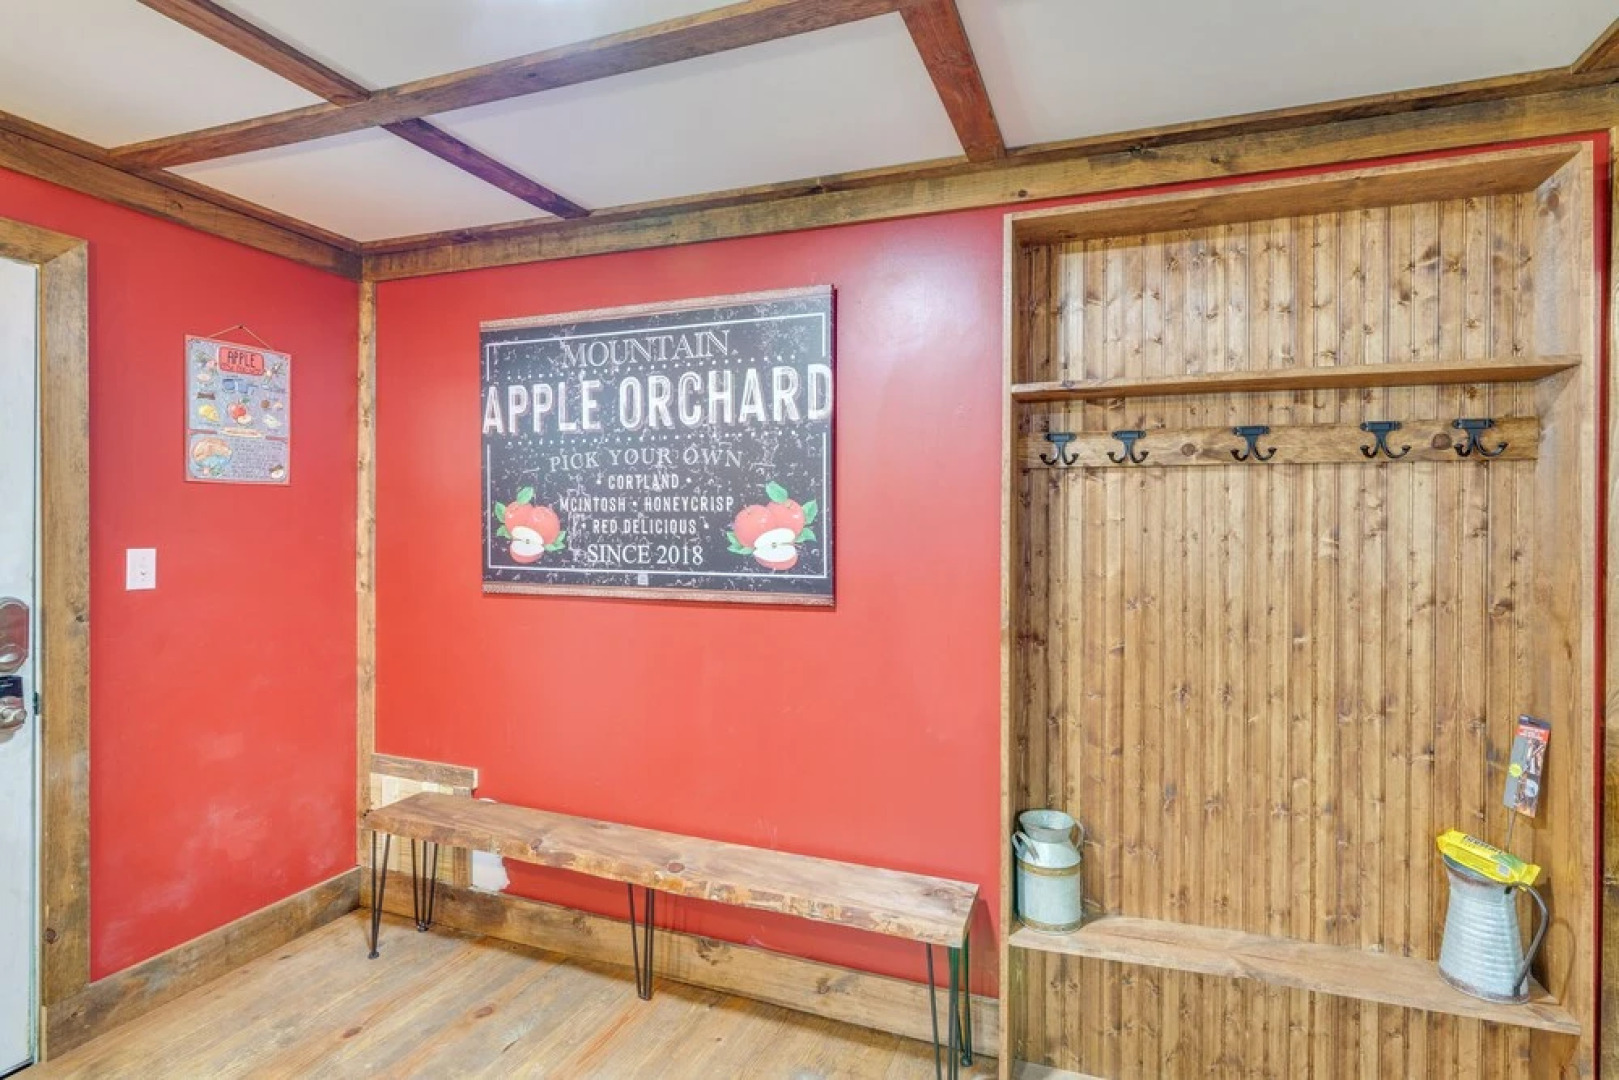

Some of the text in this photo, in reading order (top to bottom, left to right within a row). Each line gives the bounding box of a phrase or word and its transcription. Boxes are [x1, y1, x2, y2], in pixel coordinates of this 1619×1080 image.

[227, 350, 255, 368] APPLE
[563, 330, 730, 368] MOUNTAIN
[482, 363, 833, 433] APPLE ORCHARD
[549, 447, 745, 472] PICK YOUR OWN
[608, 474, 679, 490] CORTLAND
[559, 496, 734, 512] MCINTOSH HONEYCRISP
[592, 519, 697, 534] RED DELICIOUS
[587, 543, 704, 565] SINCE 2018
